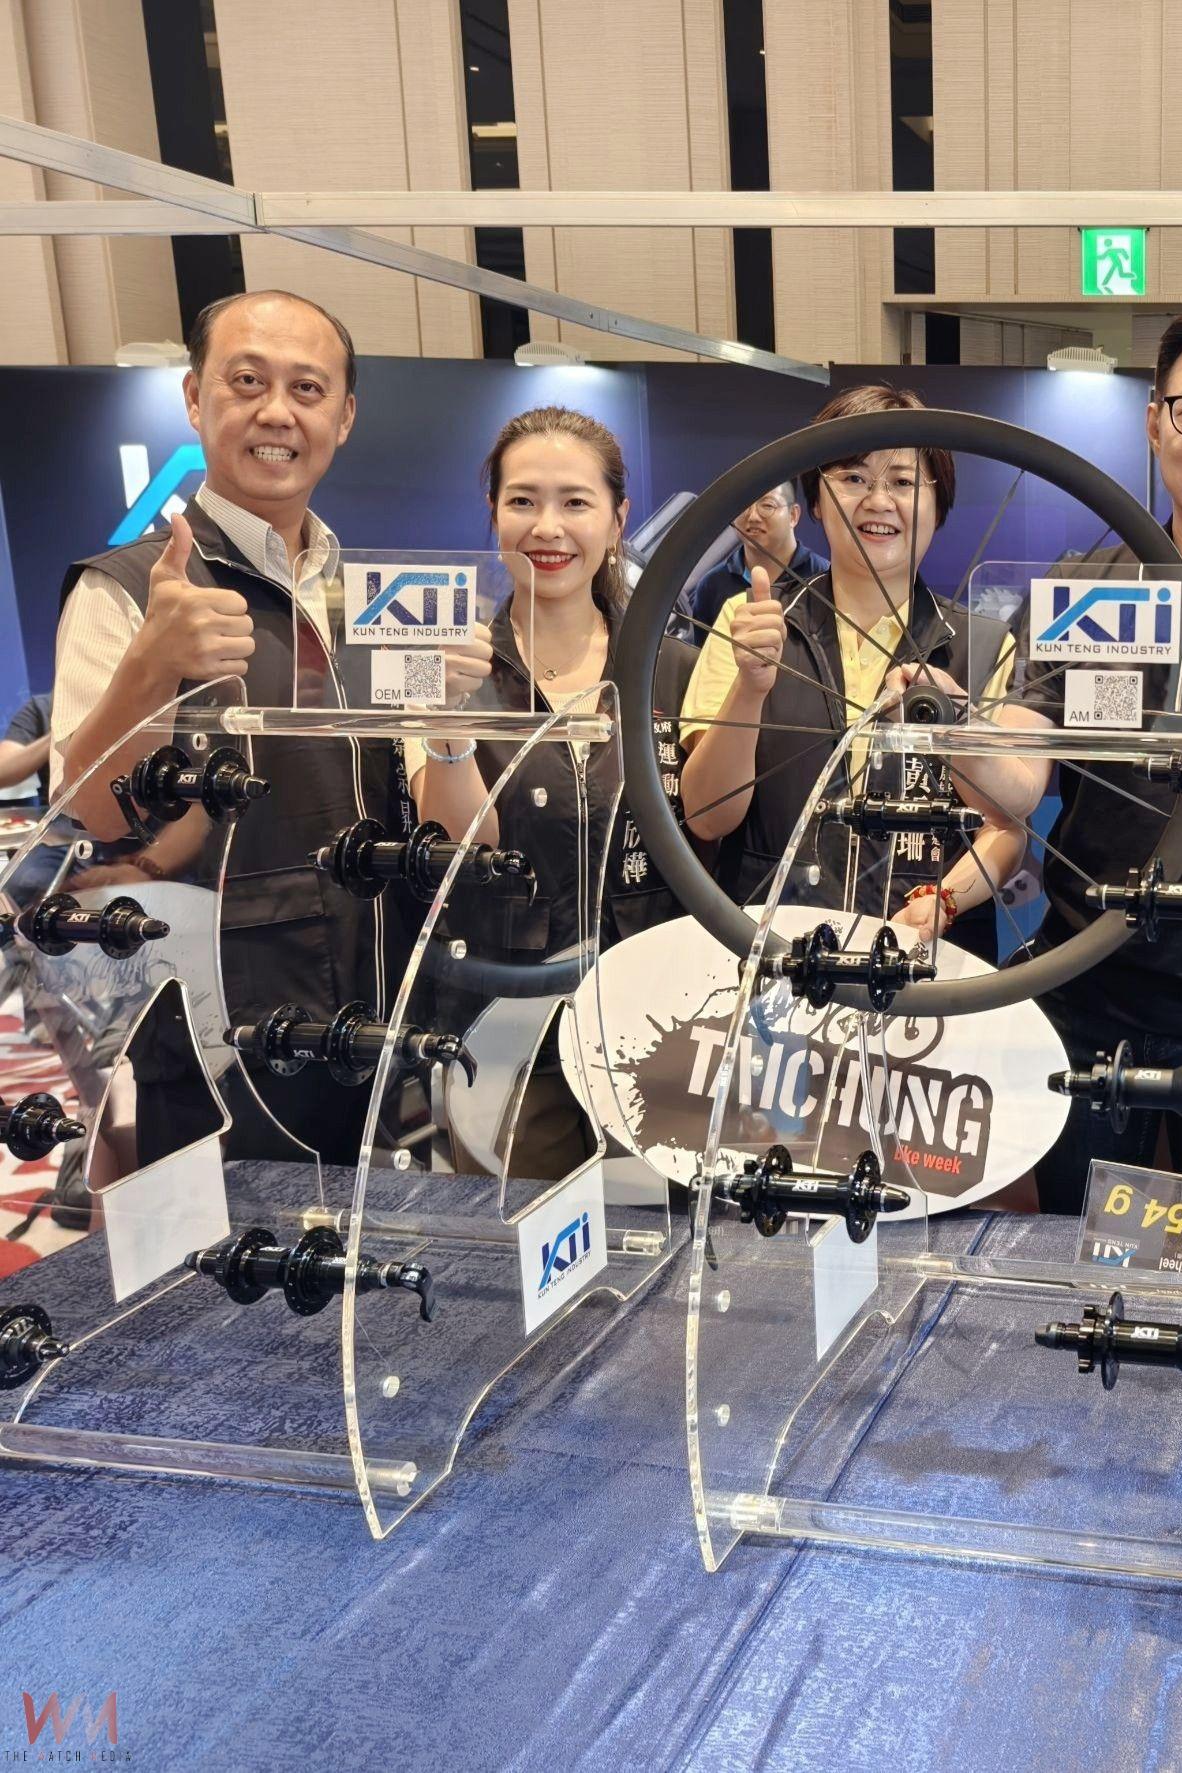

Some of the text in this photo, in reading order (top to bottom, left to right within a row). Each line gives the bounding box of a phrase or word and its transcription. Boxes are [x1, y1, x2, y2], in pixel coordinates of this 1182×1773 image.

[353, 627, 468, 637] KUN TENG INDUSTRY
[1036, 643, 1172, 655] KUN TENG INDUSTRY
[375, 689, 401, 700] OEM
[1069, 711, 1090, 722] AM
[688, 1026, 985, 1156] TAICHUNG
[923, 1155, 962, 1175] week
[1104, 1184, 1134, 1215] g
